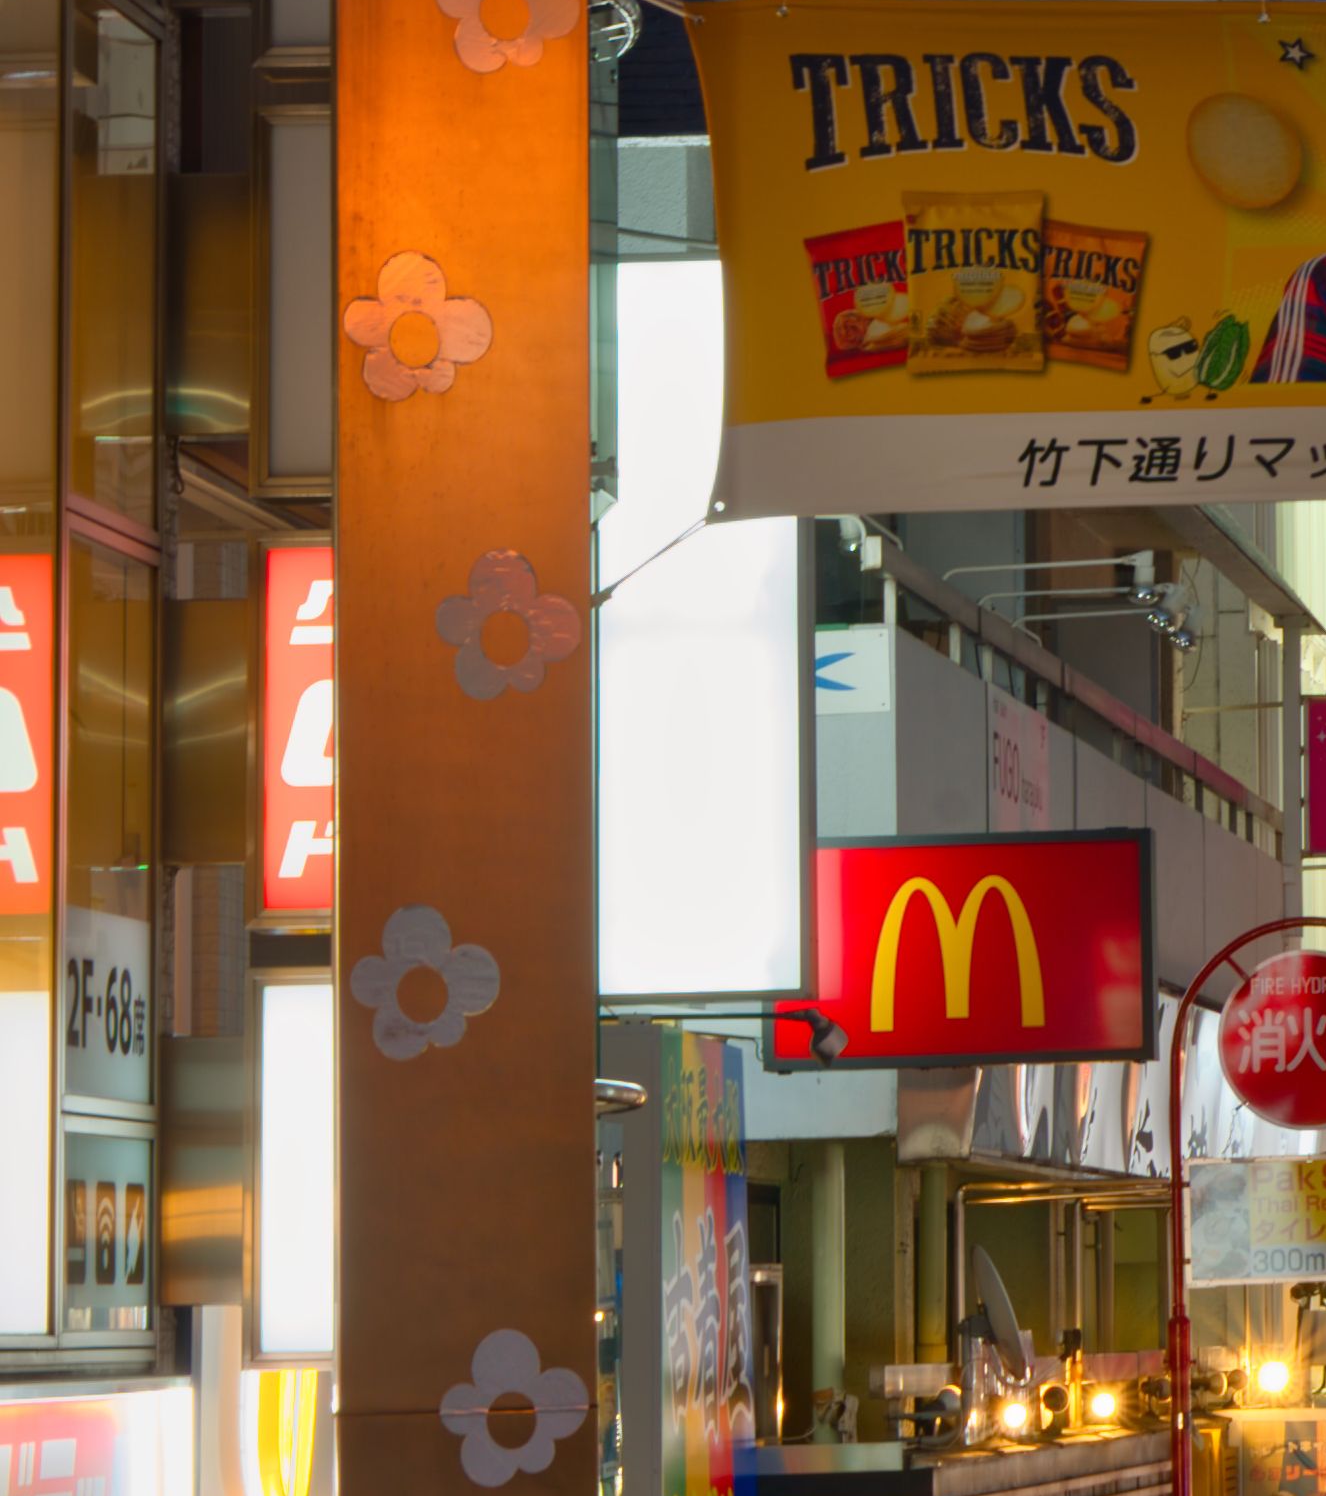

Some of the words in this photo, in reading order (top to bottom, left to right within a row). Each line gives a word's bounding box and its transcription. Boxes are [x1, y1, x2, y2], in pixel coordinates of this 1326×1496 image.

[789, 50, 1138, 171] TRICKS
[908, 226, 1042, 276] TRICKS
[814, 248, 907, 301] TRICK
[1251, 977, 1285, 995] FIRE
[1252, 1165, 1316, 1192] Pak
[1253, 1195, 1299, 1216] Thai
